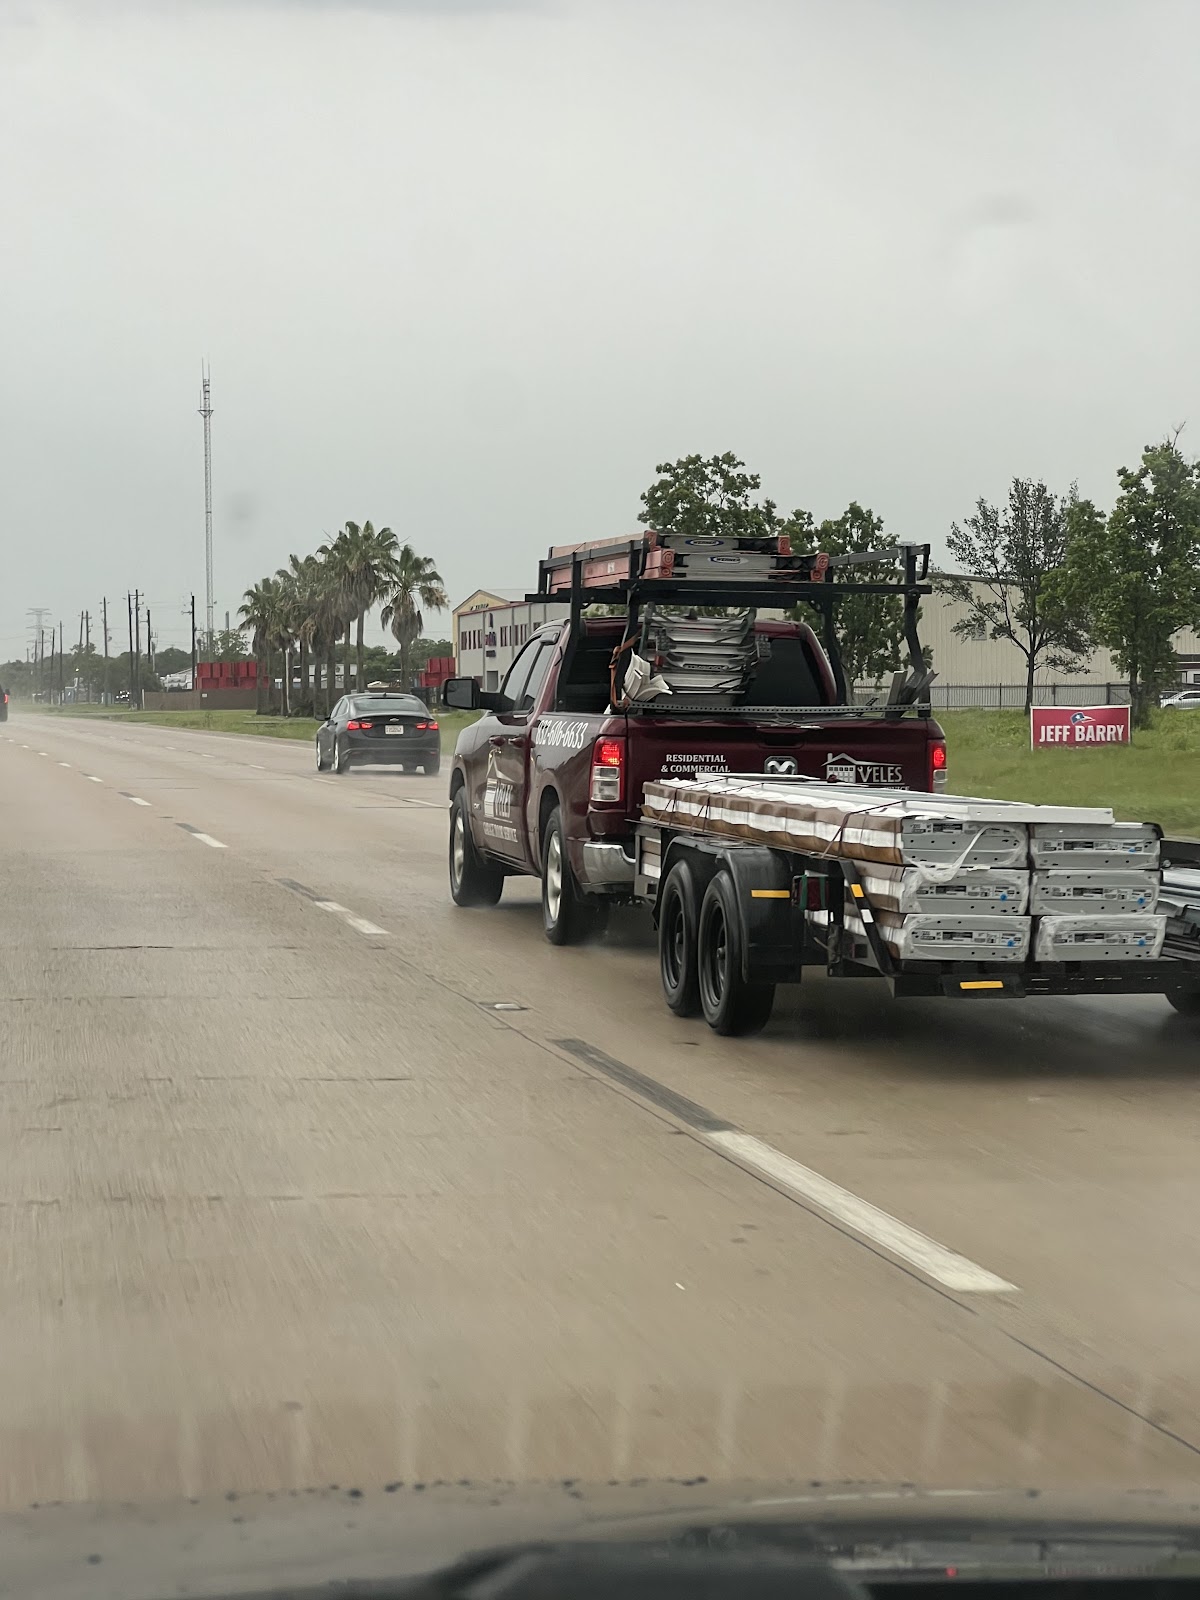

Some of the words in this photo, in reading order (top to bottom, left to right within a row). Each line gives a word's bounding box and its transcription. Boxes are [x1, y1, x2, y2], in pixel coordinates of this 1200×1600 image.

[536, 719, 589, 749] 832-606-6633
[1039, 725, 1071, 742] JEFF
[1075, 724, 1125, 742] BARRY
[666, 754, 727, 763] RESIDENTIAL
[660, 764, 669, 773] &
[670, 765, 731, 773] COMMERCIAL
[857, 766, 903, 783] VELES
